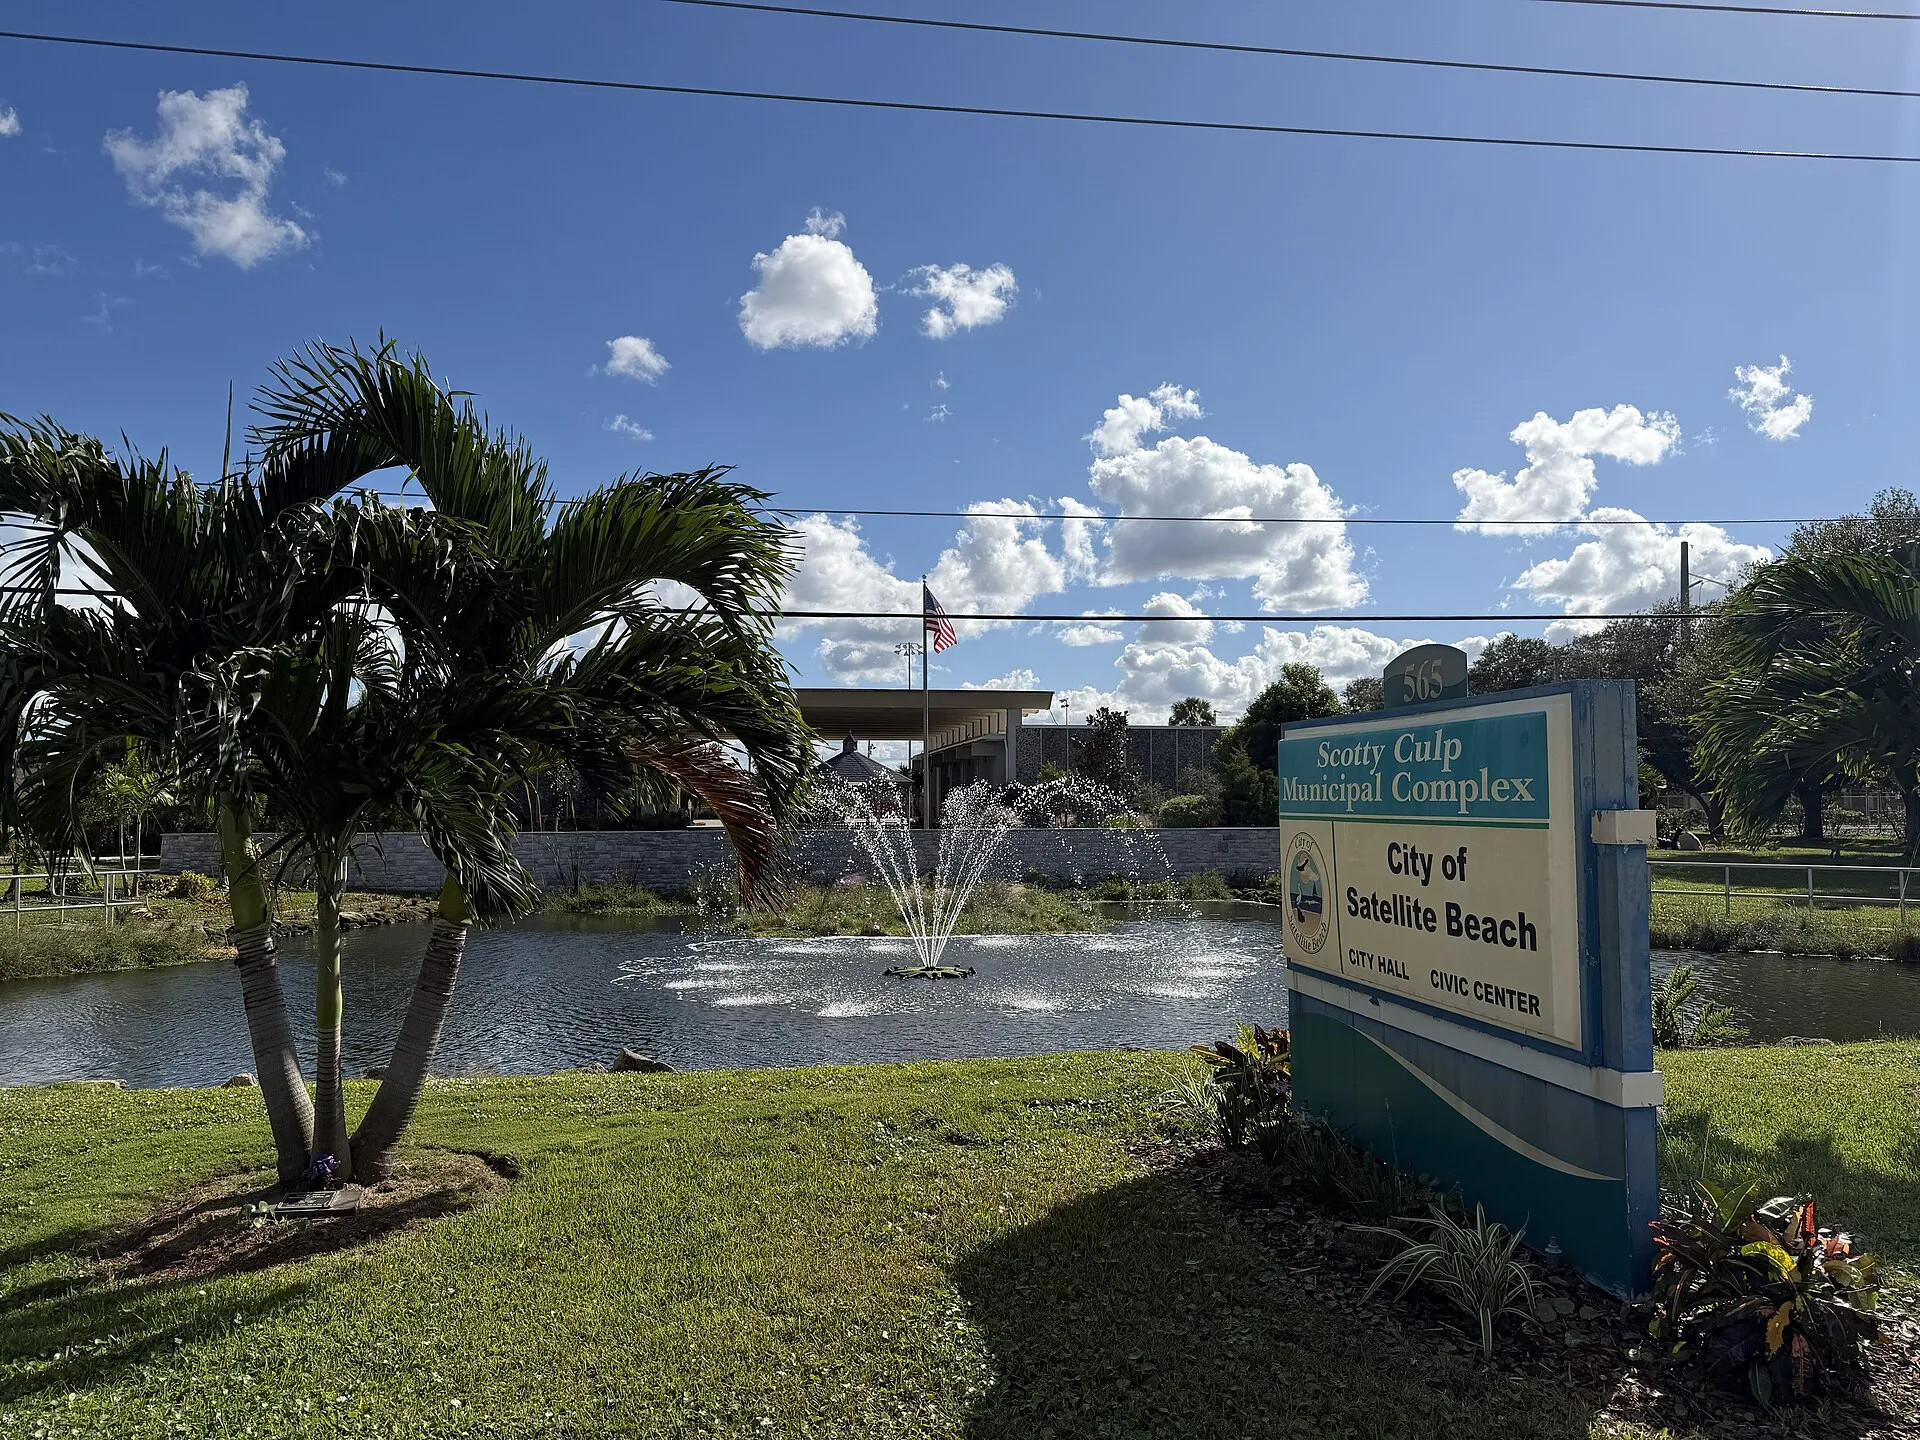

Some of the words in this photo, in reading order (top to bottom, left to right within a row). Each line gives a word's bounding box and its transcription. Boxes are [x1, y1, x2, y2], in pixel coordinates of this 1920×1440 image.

[1402, 658, 1443, 702] 565
[1317, 740, 1386, 775] Scotty
[1394, 728, 1462, 773] Culp
[1282, 772, 1382, 812] Municipal
[1391, 767, 1536, 814] Complex
[1387, 841, 1433, 887] City
[1441, 846, 1468, 882] of
[1346, 886, 1437, 933] Satellite
[1446, 901, 1537, 952] Beach
[1348, 948, 1375, 972] CITY
[1378, 956, 1410, 981] HALL
[1430, 969, 1469, 998] CIVIC
[1473, 980, 1542, 1017] CENTER
